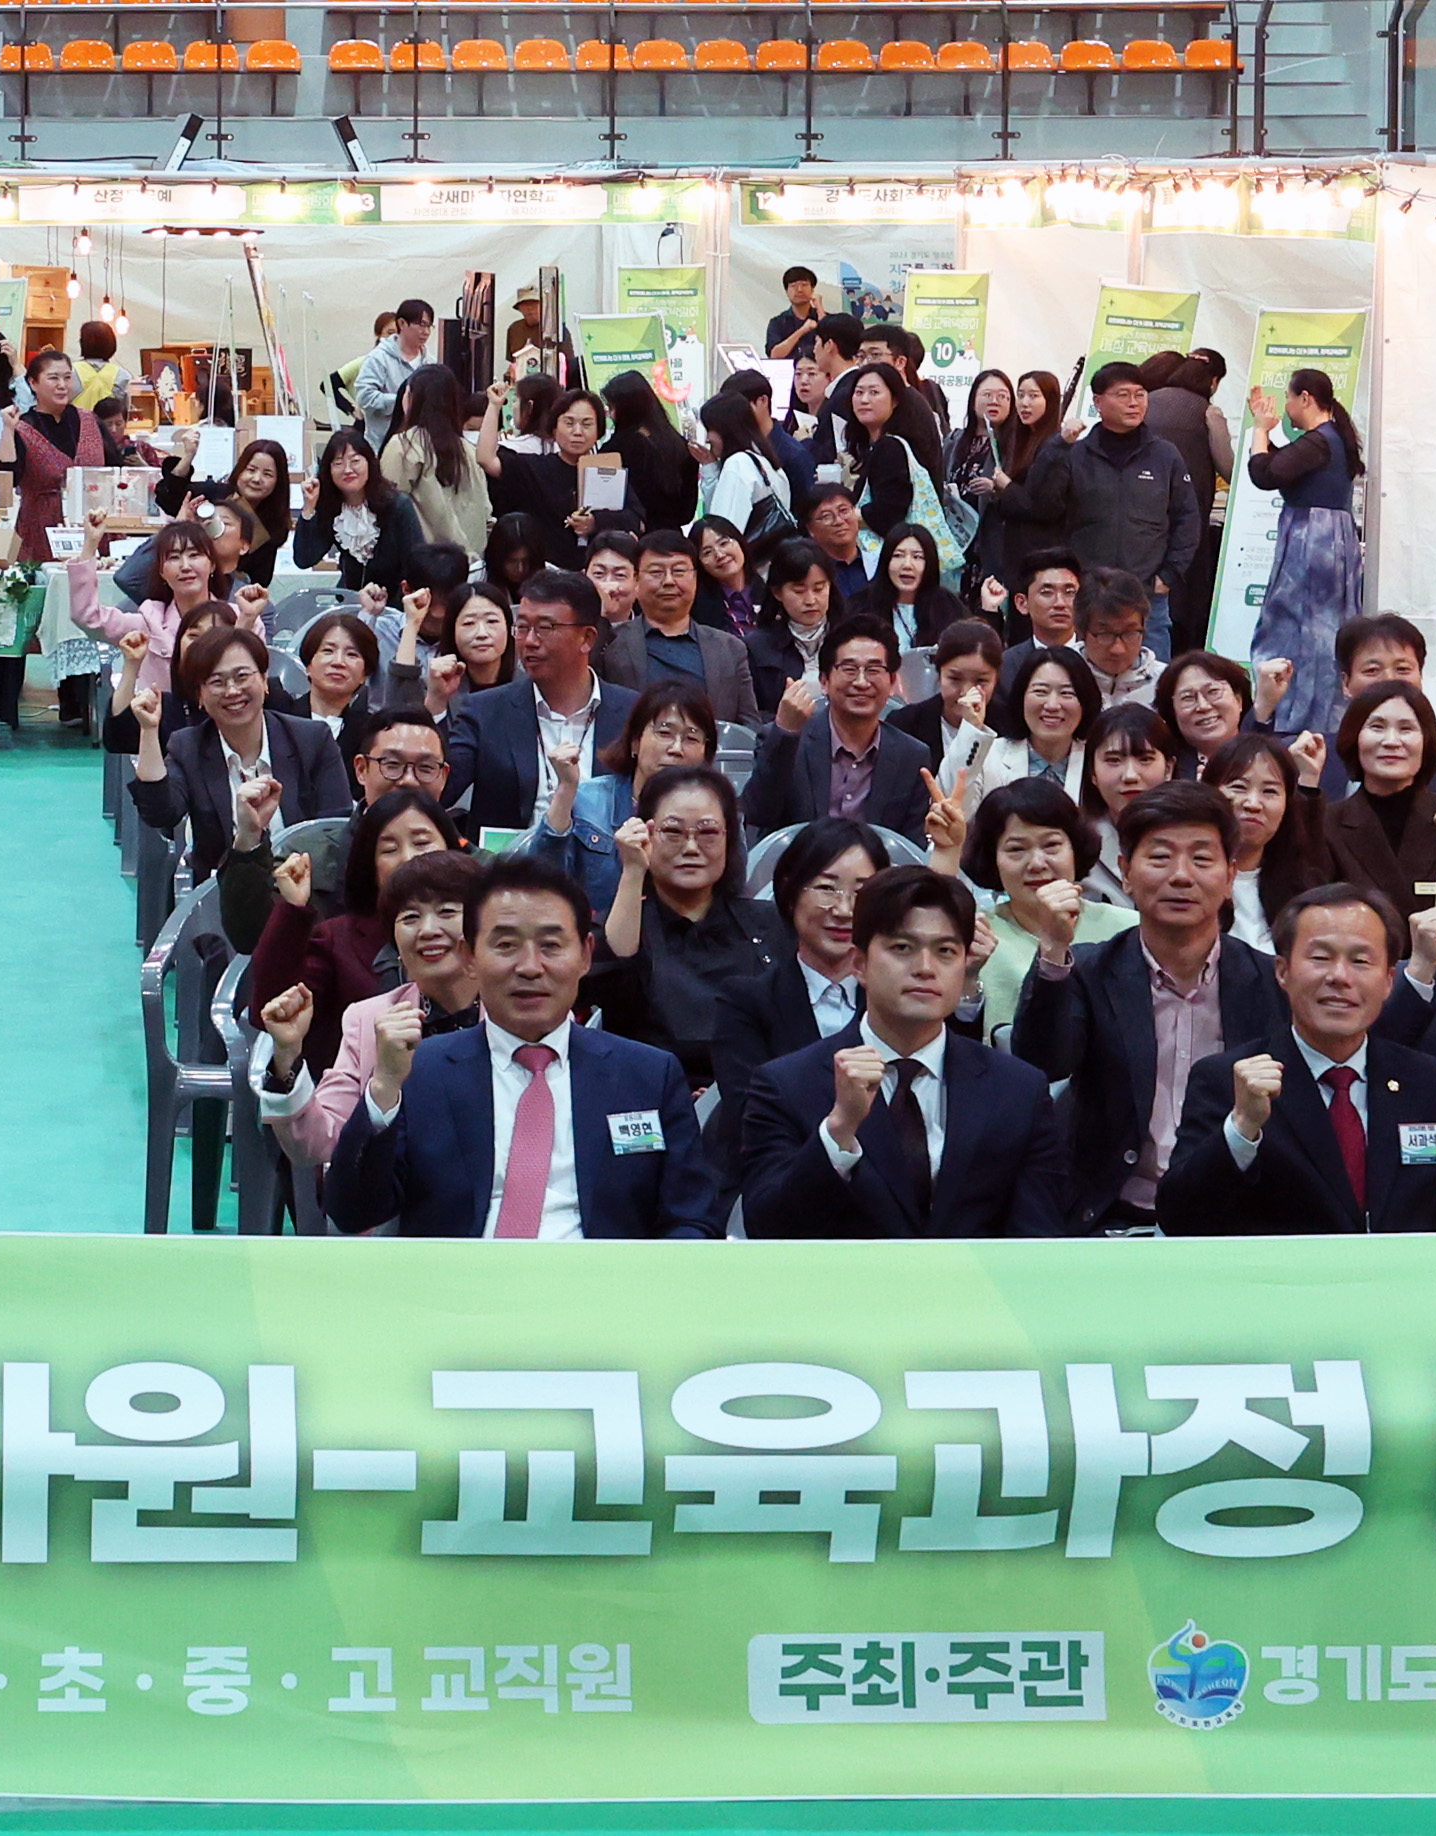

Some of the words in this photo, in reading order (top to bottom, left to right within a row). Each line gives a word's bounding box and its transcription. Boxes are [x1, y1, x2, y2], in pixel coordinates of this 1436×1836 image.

[935, 343, 953, 360] 10
[618, 1119, 654, 1140] 백영현
[421, 1642, 633, 1715] 교직원
[777, 1641, 1088, 1711] 주최·주관
